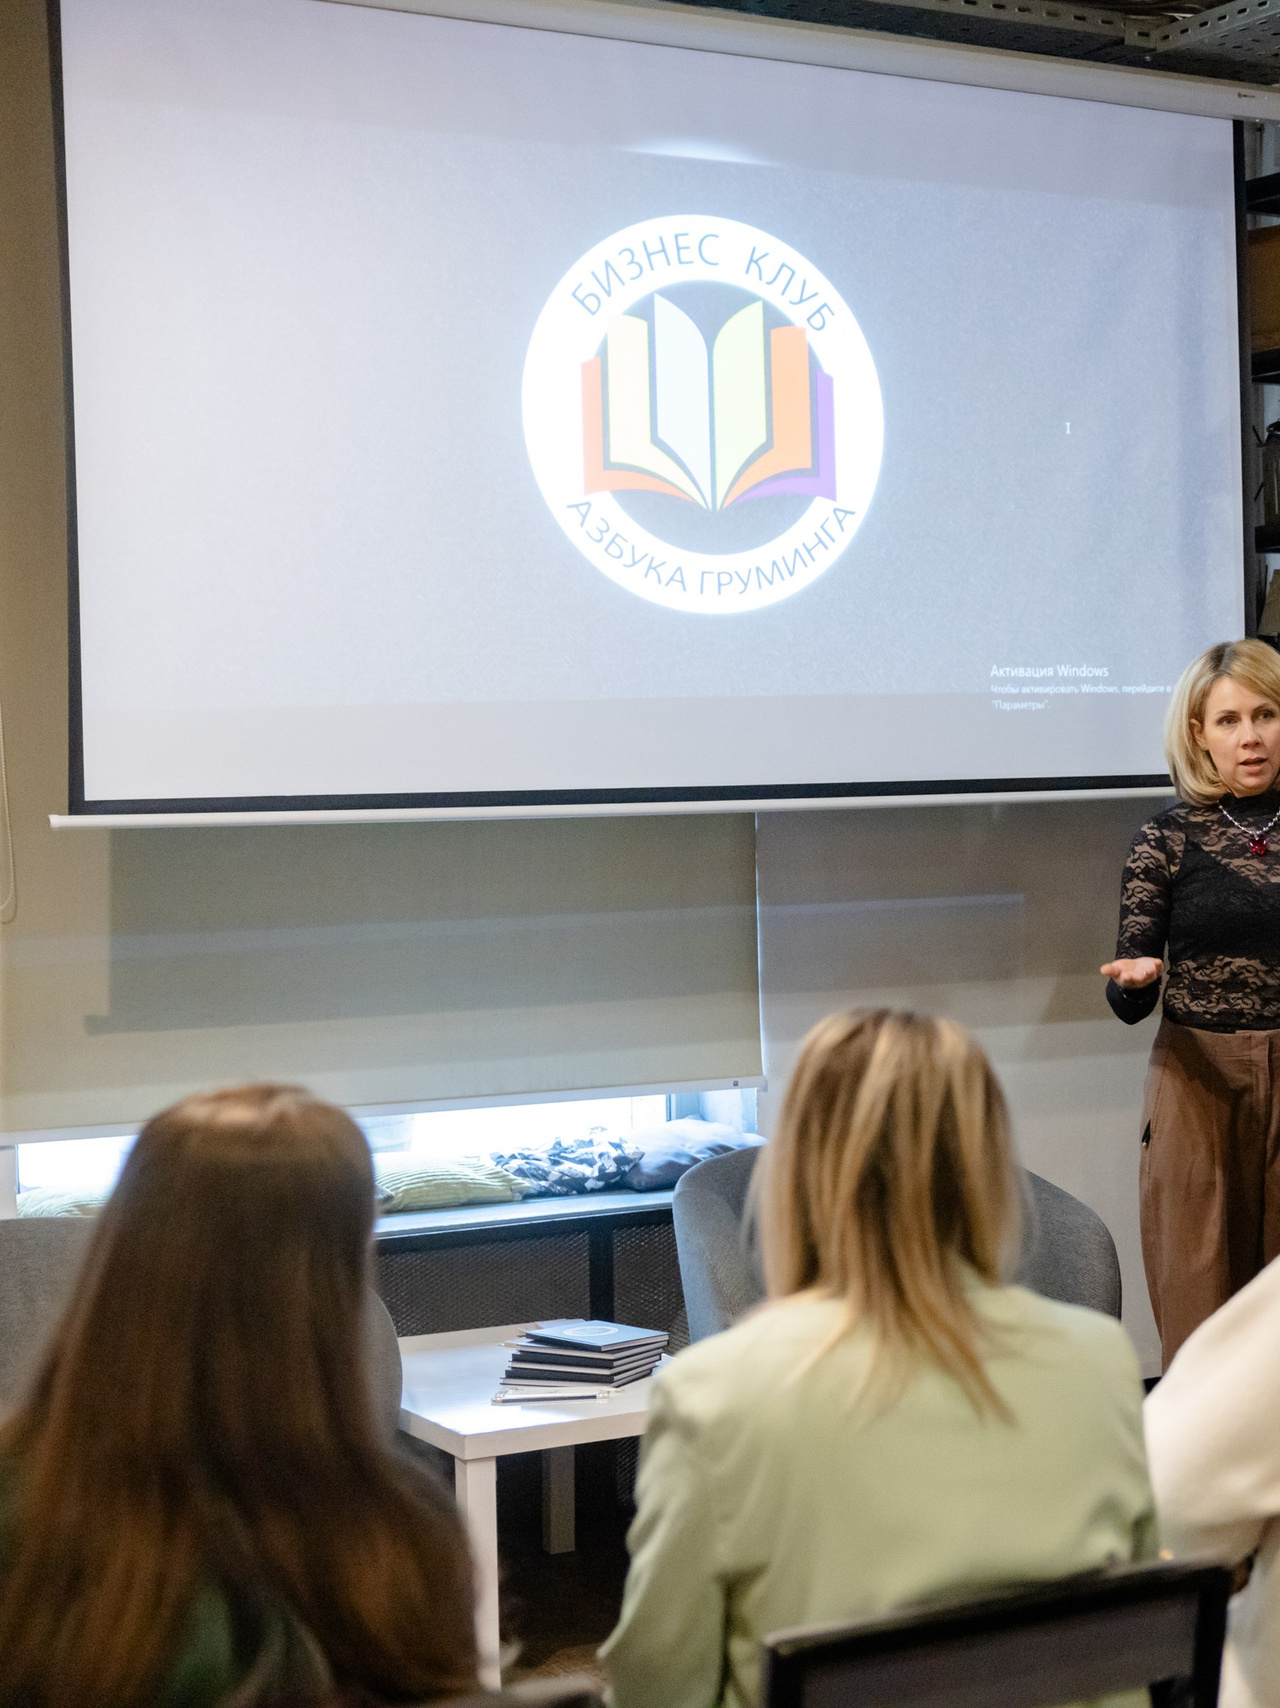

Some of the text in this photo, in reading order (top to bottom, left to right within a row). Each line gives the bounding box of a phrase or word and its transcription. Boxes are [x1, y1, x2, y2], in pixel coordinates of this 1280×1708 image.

[571, 233, 835, 331] БИЗНЕС КЛУБ
[566, 501, 856, 595] АЗБУКА ГРУМИНГА
[990, 664, 1109, 678] Активация Windows
[991, 684, 1019, 694] Чтобы
[1021, 686, 1079, 696] активировать
[1122, 684, 1165, 695] перейдите
